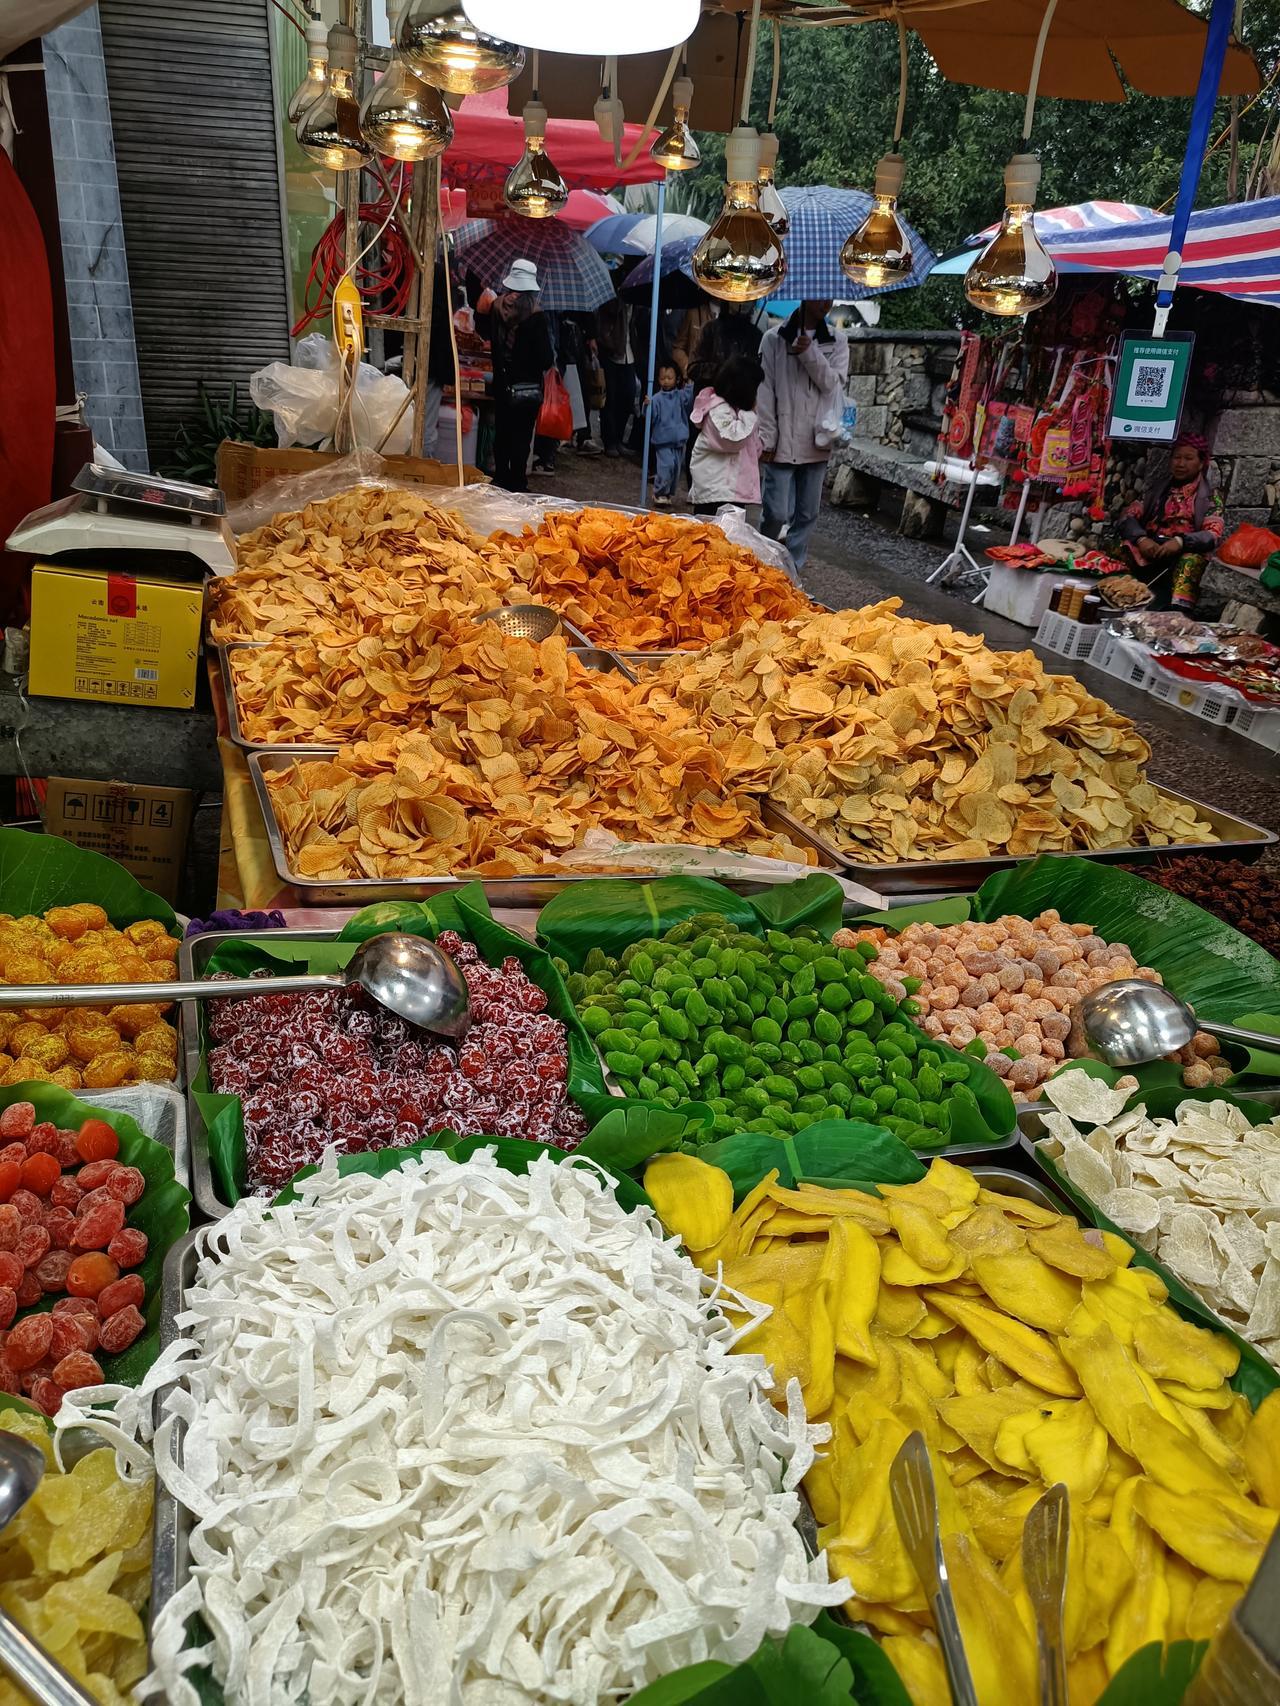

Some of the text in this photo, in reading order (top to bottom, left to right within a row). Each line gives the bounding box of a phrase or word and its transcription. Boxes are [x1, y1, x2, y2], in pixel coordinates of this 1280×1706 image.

[1133, 347, 1179, 356] 推荐使用微信支付
[1134, 425, 1161, 433] 微信支付
[155, 804, 168, 818] 4
